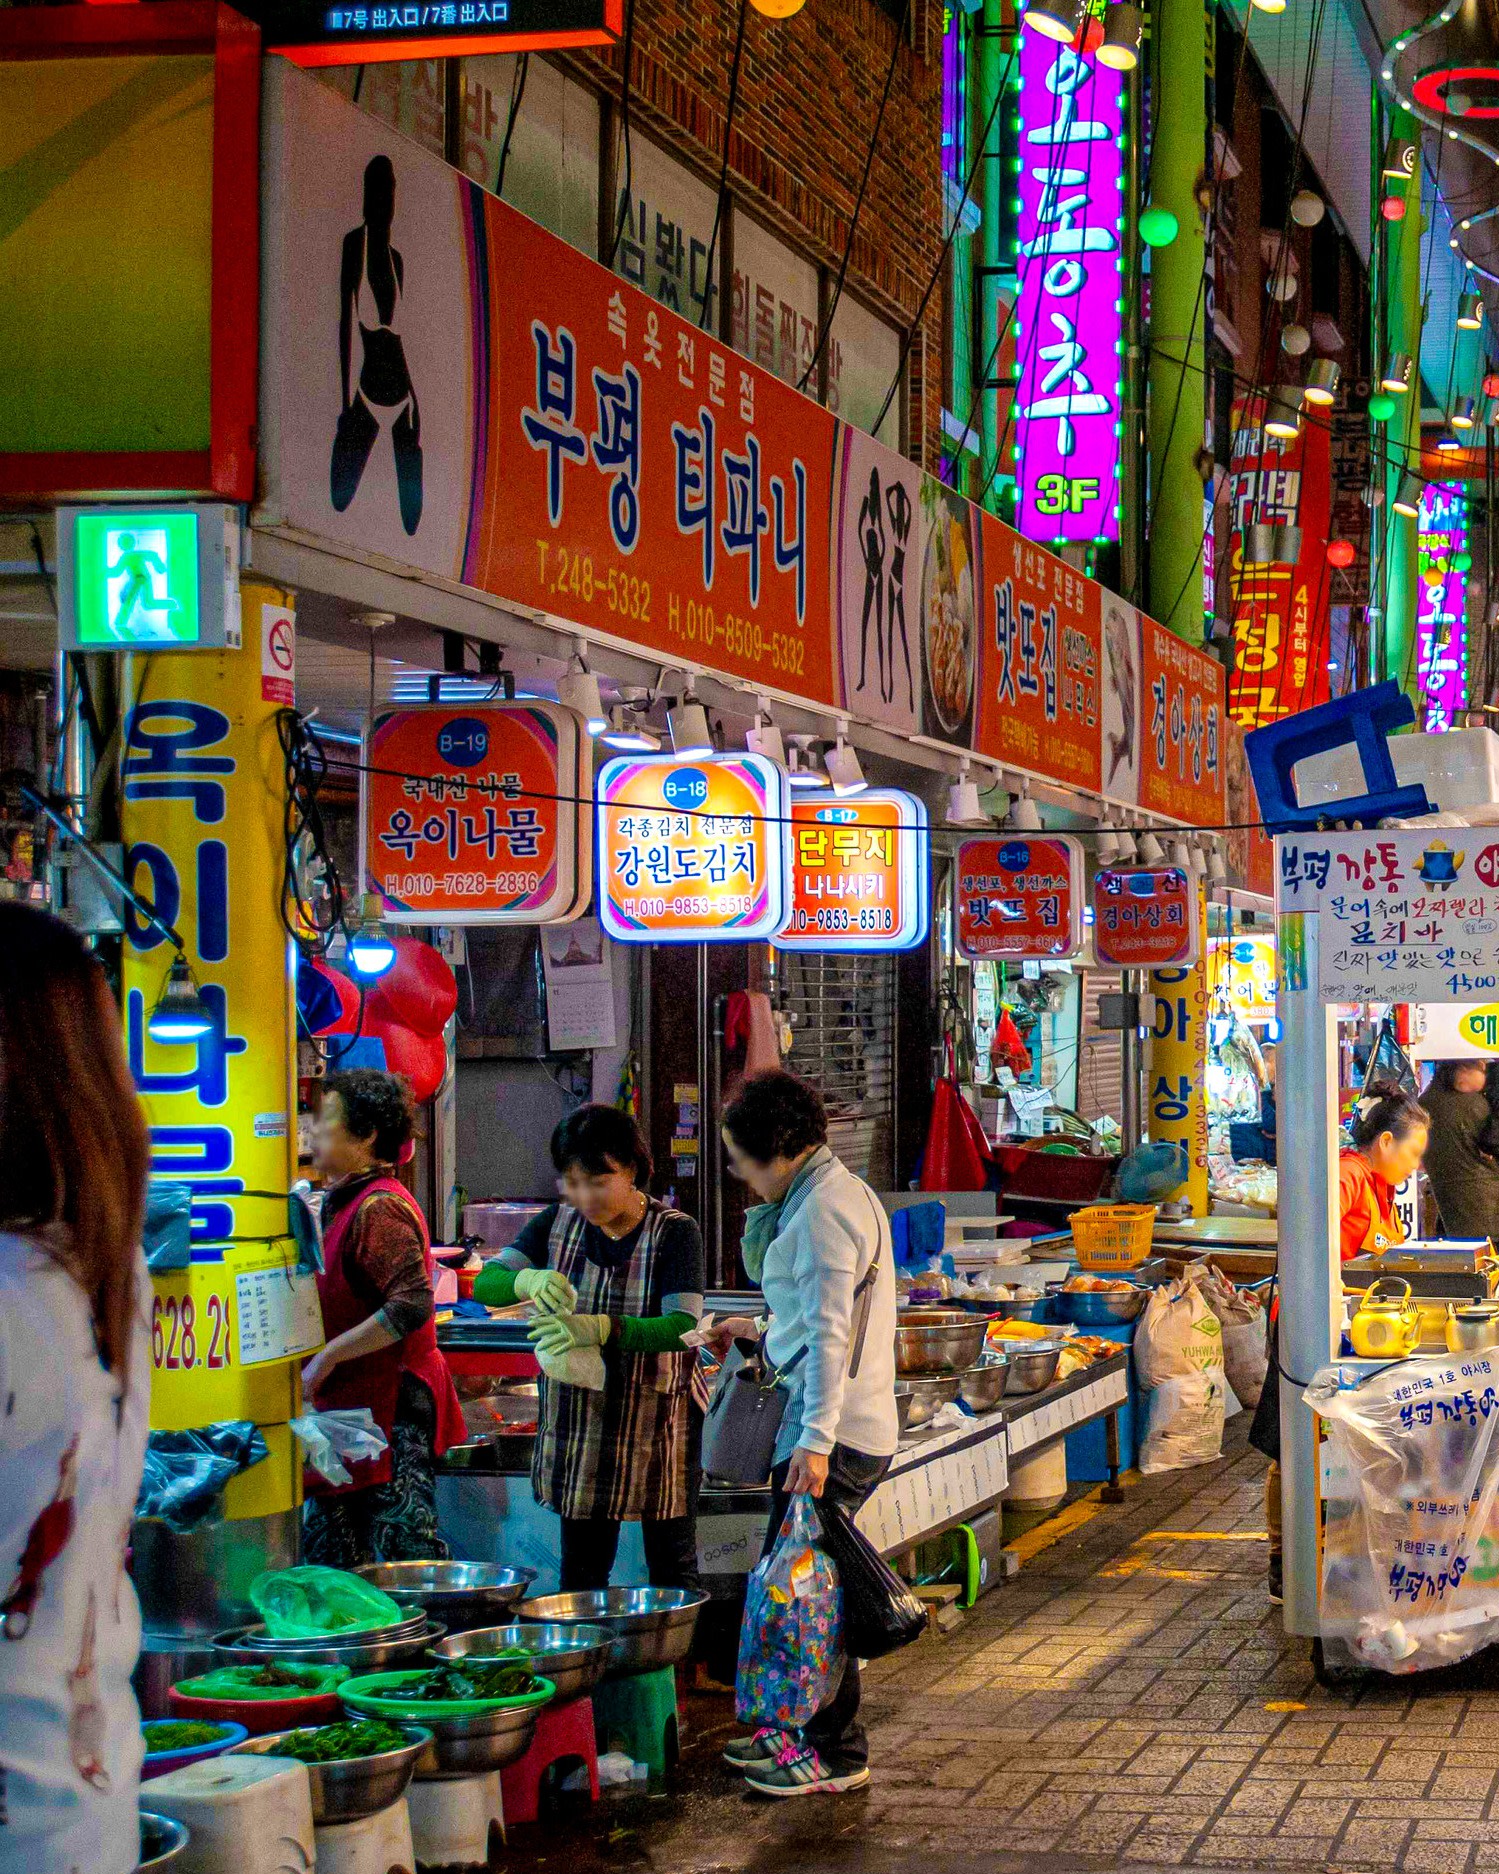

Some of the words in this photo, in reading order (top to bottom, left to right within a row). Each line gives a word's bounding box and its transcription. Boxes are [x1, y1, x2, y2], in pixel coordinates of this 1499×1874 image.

[608, 289, 756, 425] 속옷전문점
[520, 318, 642, 557] 부평
[671, 405, 806, 629] 티파니
[1035, 473, 1101, 516] 3F
[536, 538, 652, 624] T.248-5332
[667, 592, 806, 678] H.010-8509-5332
[439, 733, 487, 752] B-19
[1151, 671, 1220, 794] 경아상회
[665, 781, 707, 798] B-18
[380, 806, 545, 861] 옥이나물
[618, 815, 690, 838] 각종김치
[701, 814, 754, 836] 전문점
[615, 841, 757, 887] 강원도김치
[798, 828, 894, 867] 단무지
[385, 871, 539, 896] H.010-7628-2836
[1281, 846, 1331, 894] 부평
[1337, 842, 1405, 894] 깡통
[804, 874, 885, 900] 나나시키
[624, 896, 753, 918] H.010-9853-8518
[1101, 903, 1184, 930] 경아상회
[1461, 1360, 1492, 1378] 야시장
[703, 1534, 748, 1562] posco
